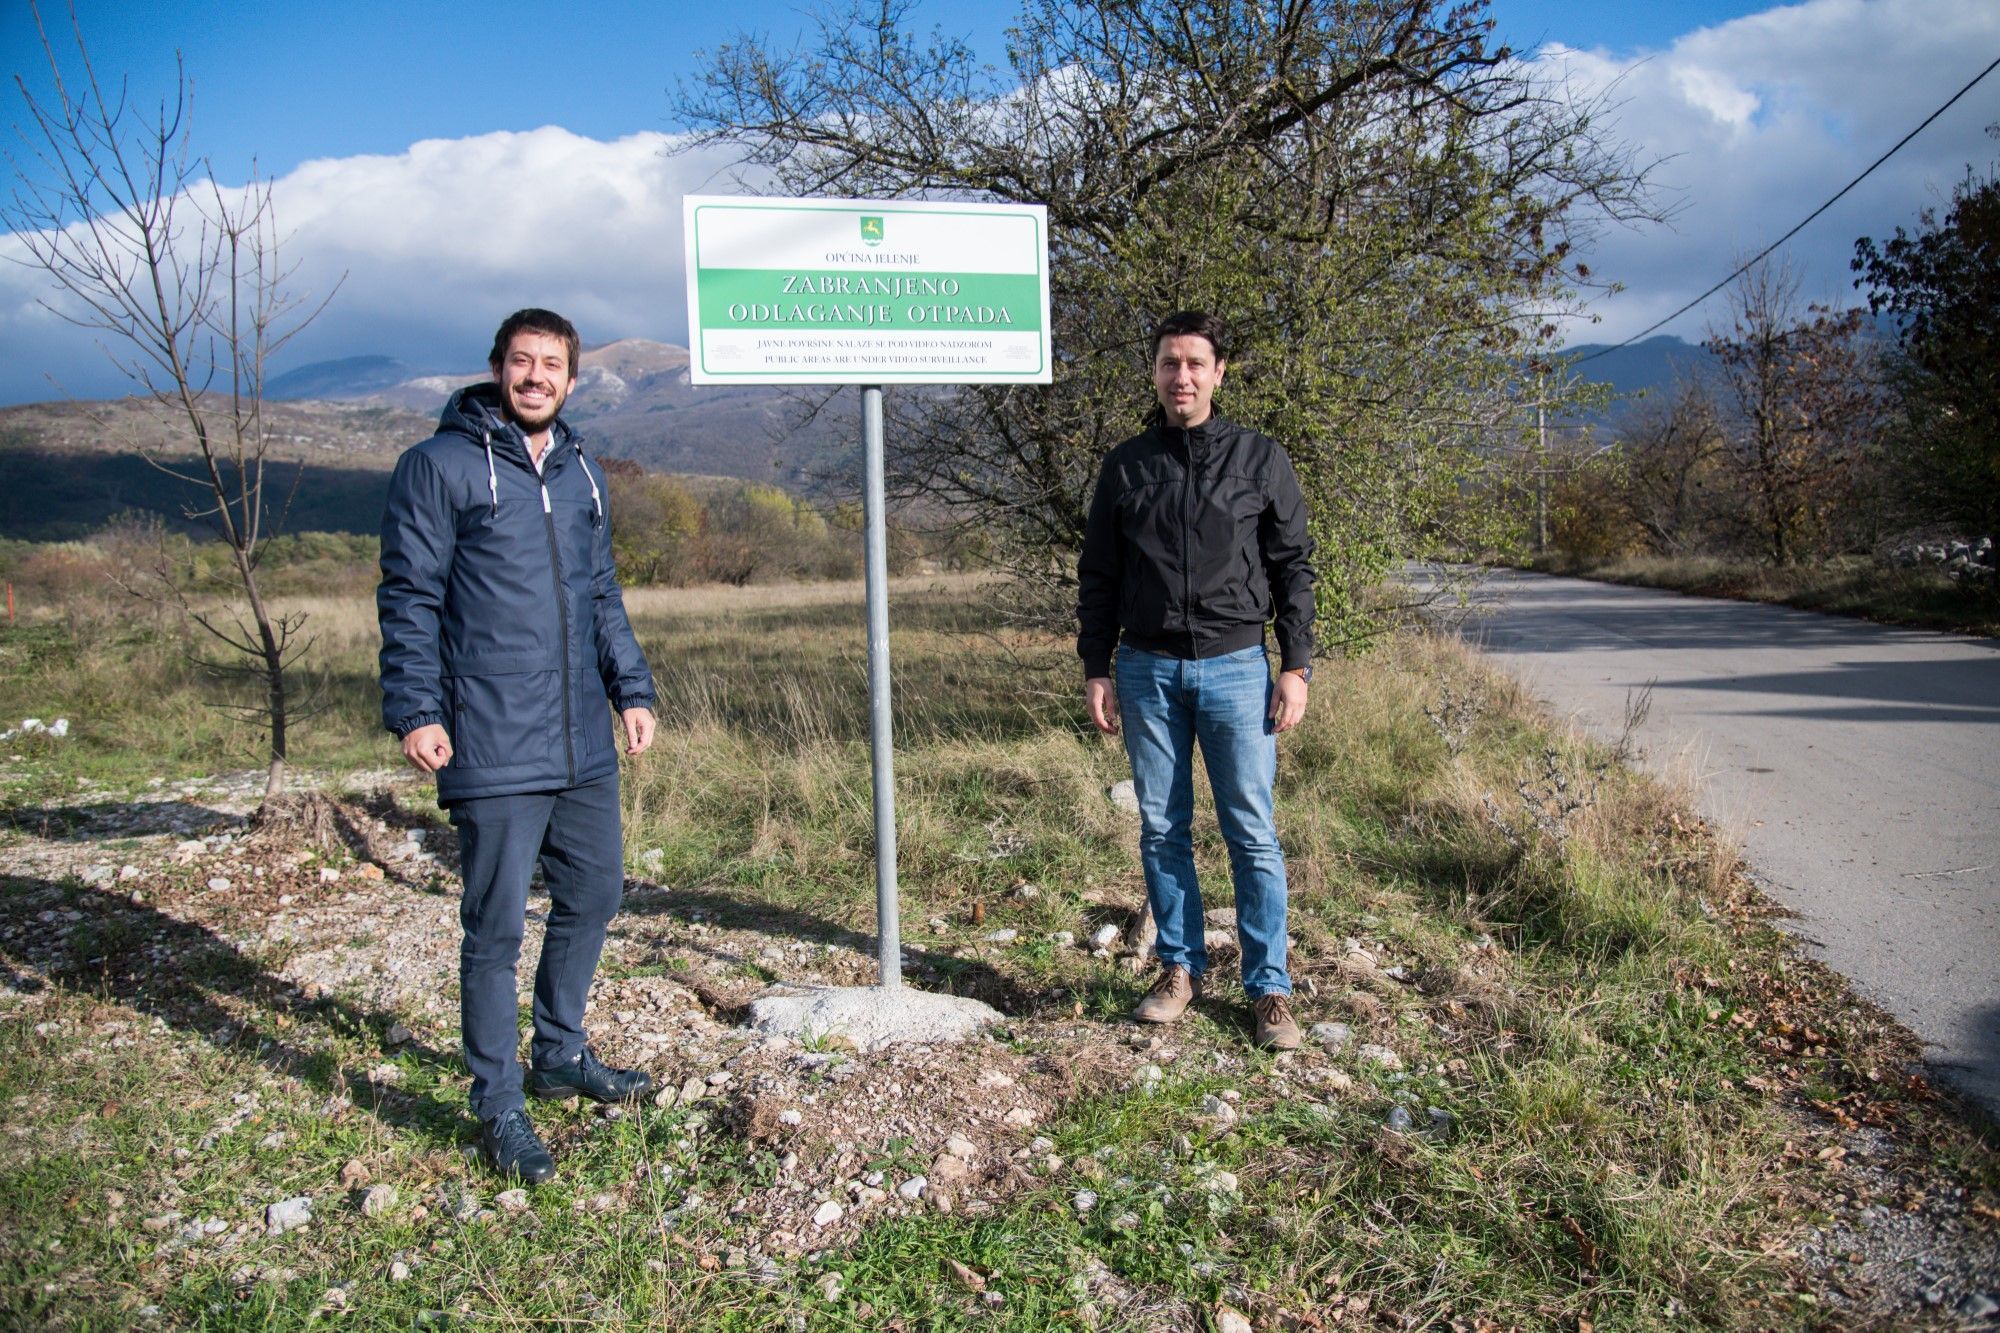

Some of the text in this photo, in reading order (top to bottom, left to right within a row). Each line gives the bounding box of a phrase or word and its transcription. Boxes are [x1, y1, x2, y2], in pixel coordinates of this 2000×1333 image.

[875, 254, 921, 265] JELENJE
[782, 275, 960, 300] ZABRANJENO
[728, 303, 1013, 327] ODLAGANJE OTPADA
[757, 338, 992, 349] JAVNE POVRŠINE NALAZE SE POD VIDEO NADZOROM
[765, 355, 987, 364] PUBLIC AREAS ARE UNDER VIDEO SURVEILLANCE
